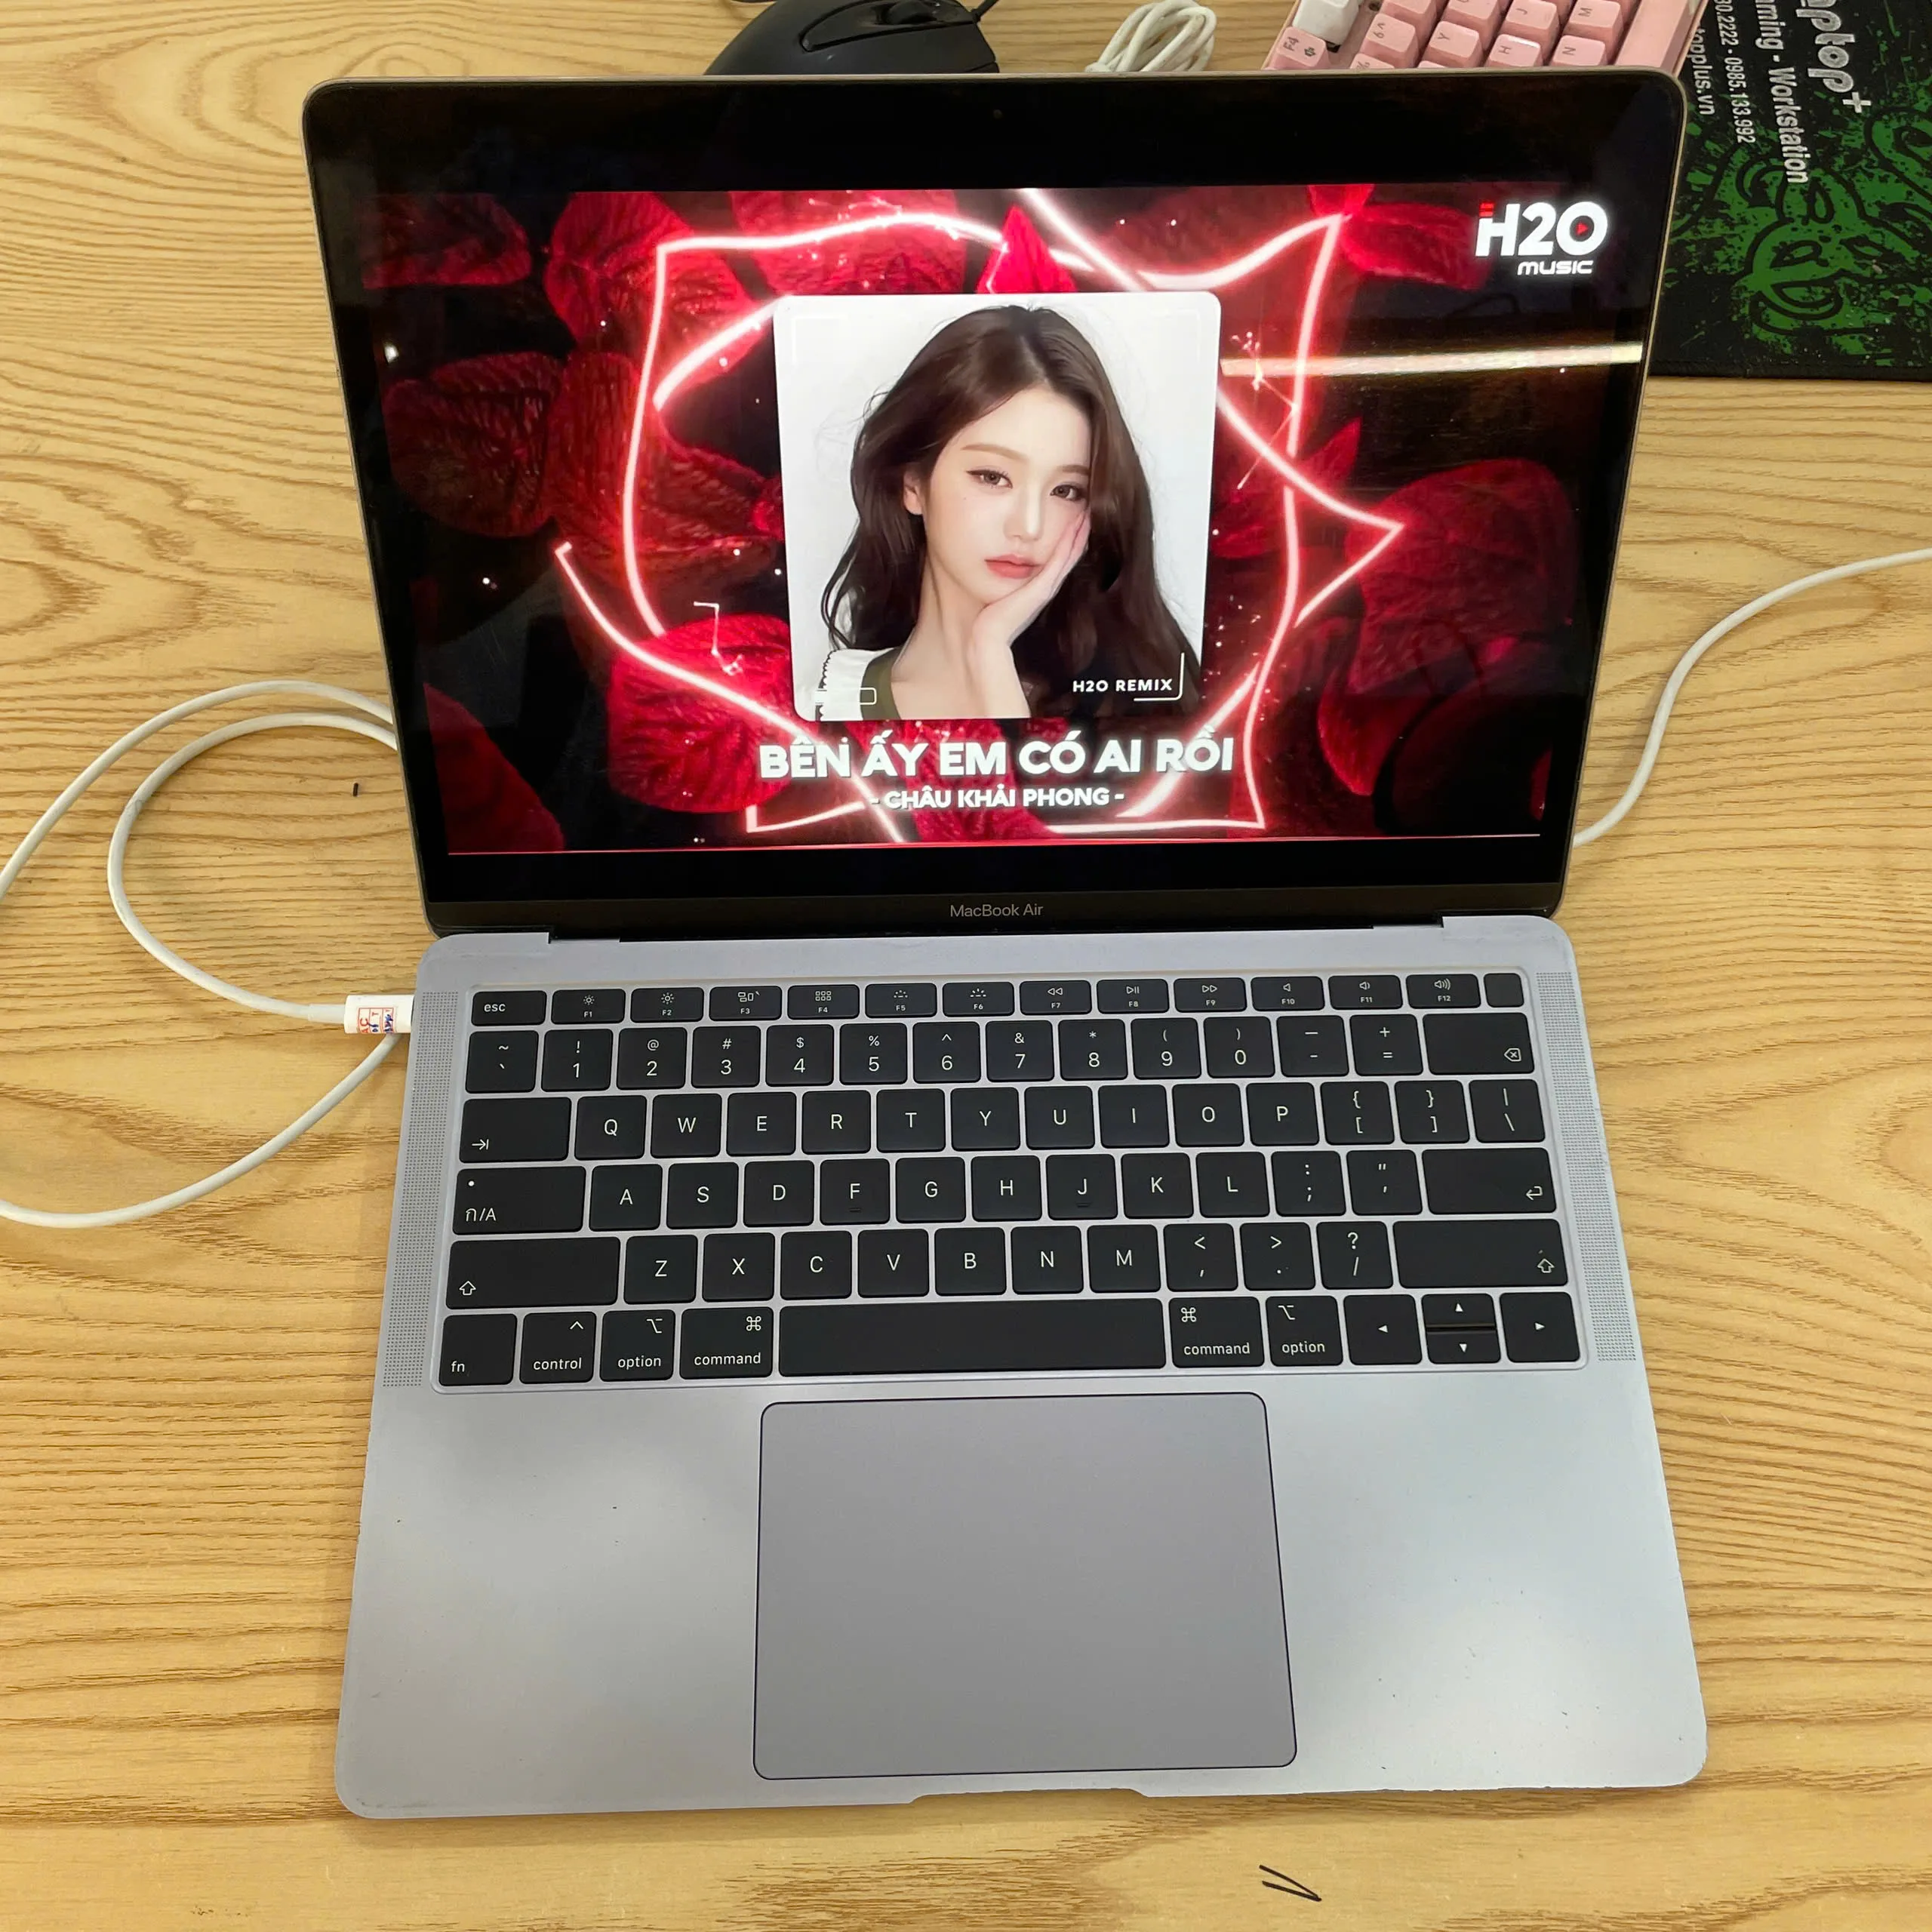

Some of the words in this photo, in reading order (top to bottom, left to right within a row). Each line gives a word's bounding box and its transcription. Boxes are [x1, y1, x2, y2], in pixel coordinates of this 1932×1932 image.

[1755, 0, 1786, 51] ming
[1283, 35, 1300, 52] F4
[1498, 45, 1512, 54] H
[1795, 0, 1872, 113] ptop+
[1686, 23, 1715, 115] topplus.vn
[1724, 57, 1756, 143] 0985.133.992
[1768, 67, 1811, 183] Workstation
[1475, 201, 1609, 257] H2O
[1115, 678, 1173, 692] REMIX
[758, 734, 851, 779] BÊN
[860, 729, 929, 777] ẤY
[939, 742, 1008, 776] EM
[1018, 730, 1086, 775] CÓ
[1093, 739, 1143, 774] AI
[884, 784, 952, 810] CHÂU
[958, 783, 1017, 808] KHẢI
[1023, 786, 1110, 808] PHONG
[950, 903, 1020, 918] MacBook
[1023, 903, 1044, 916] Air
[484, 1003, 506, 1012] esc
[869, 1056, 880, 1072] 5
[941, 1055, 953, 1070] 6
[1015, 1054, 1026, 1069] 7
[1088, 1052, 1100, 1068] 8
[1161, 1051, 1173, 1066] 9
[1235, 1049, 1247, 1065] 0
[573, 1063, 580, 1078] 1
[646, 1060, 657, 1076] 2
[720, 1059, 732, 1075] 3
[793, 1058, 806, 1073] 4
[905, 1112, 917, 1128] T
[979, 1110, 992, 1127] Y
[1054, 1109, 1066, 1125] U
[1132, 1108, 1136, 1124] I
[1201, 1106, 1215, 1123] O
[1276, 1106, 1288, 1121] P
[604, 1118, 618, 1137] Q
[677, 1117, 697, 1133] W
[757, 1115, 768, 1131] E
[831, 1114, 843, 1130] R
[850, 1183, 860, 1199] F
[924, 1181, 938, 1198] G
[1000, 1180, 1014, 1196] H
[1077, 1178, 1088, 1195] J
[1151, 1177, 1164, 1193] K
[1226, 1176, 1238, 1192] L
[619, 1189, 633, 1205] A
[697, 1186, 709, 1203] S
[773, 1184, 786, 1201] D
[810, 1256, 823, 1273] C
[887, 1254, 900, 1271] V
[964, 1252, 977, 1269] B
[1041, 1251, 1054, 1268] N
[1116, 1249, 1132, 1266] M
[654, 1260, 668, 1277] Z
[731, 1258, 746, 1275] X
[1183, 1342, 1251, 1355] command
[1281, 1340, 1325, 1355] option
[451, 1361, 465, 1373] fn
[534, 1357, 582, 1371] control
[617, 1355, 661, 1371] option
[694, 1352, 761, 1366] command
